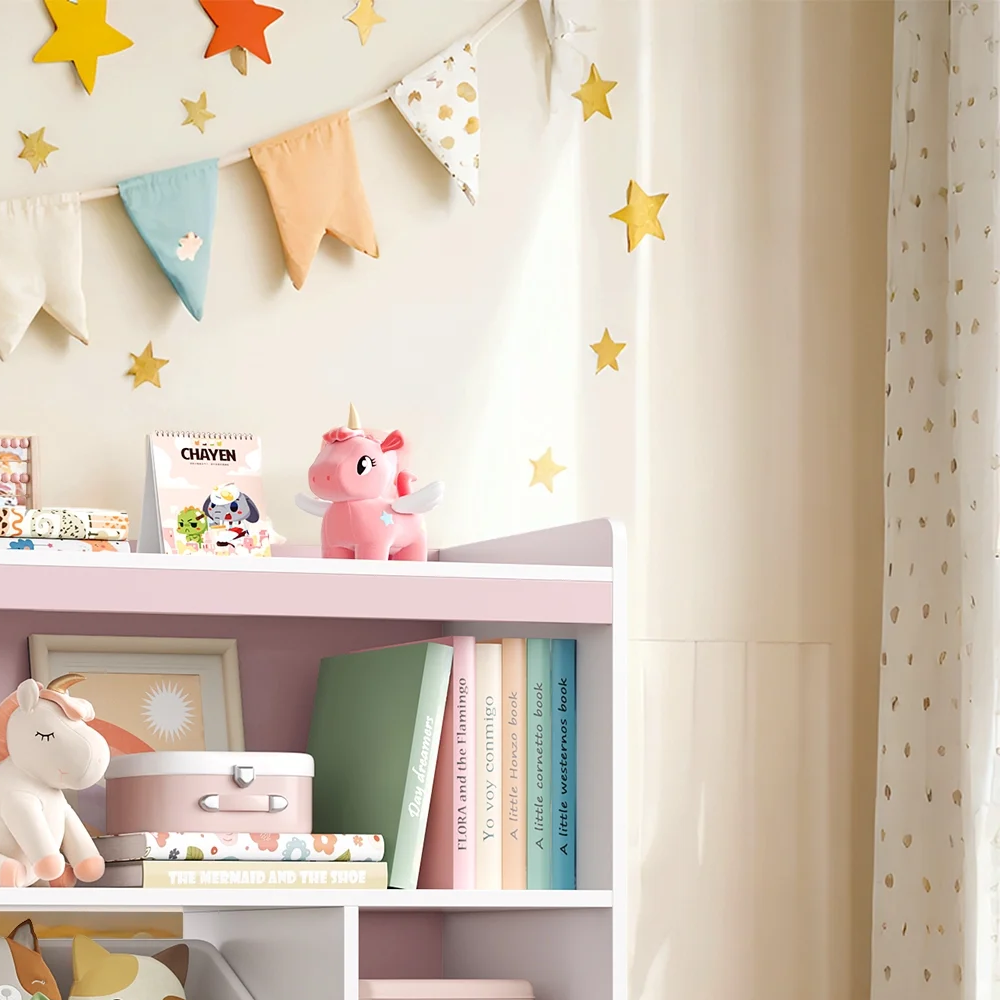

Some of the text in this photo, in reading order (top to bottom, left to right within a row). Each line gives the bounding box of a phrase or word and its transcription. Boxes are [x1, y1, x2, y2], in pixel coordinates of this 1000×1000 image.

[180, 447, 237, 462] CHAYEN
[508, 692, 517, 725] book
[457, 678, 468, 850] FLORA and the Flamingo
[483, 696, 496, 841] Yo voy conmigo
[533, 683, 543, 850] A little cornetto book
[558, 678, 568, 855] A little westernos book
[509, 787, 517, 821] little
[510, 829, 517, 840] A
[168, 870, 366, 885] THE MERMAID AND THE SHOE
